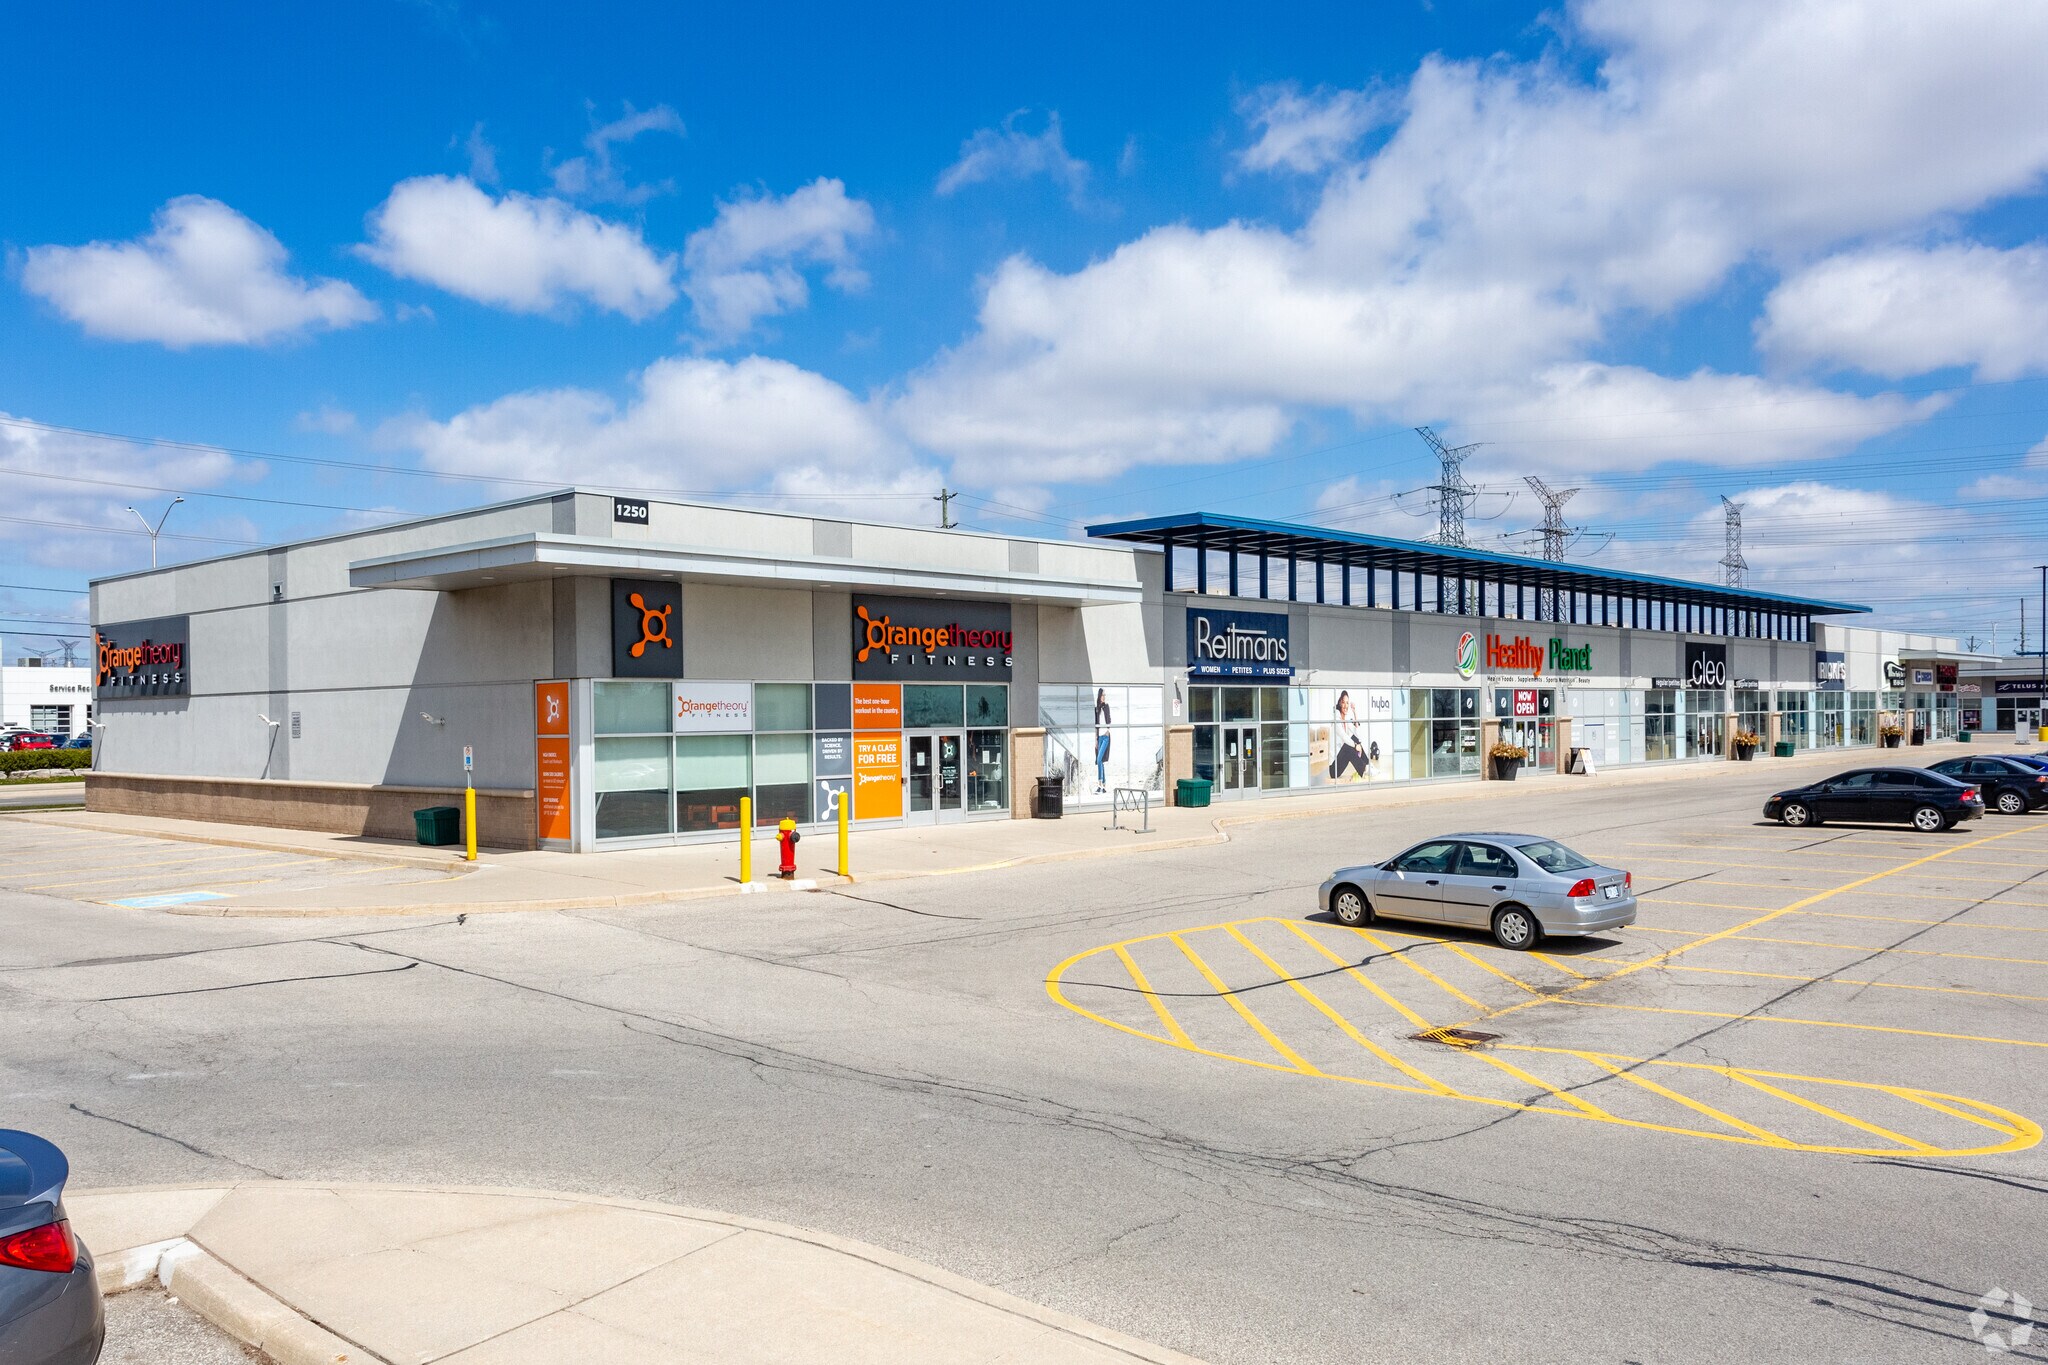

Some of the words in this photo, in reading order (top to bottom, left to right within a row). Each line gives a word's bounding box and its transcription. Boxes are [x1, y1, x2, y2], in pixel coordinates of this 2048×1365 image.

[616, 504, 647, 518] 1250
[1197, 616, 1288, 661] Reitmans
[891, 654, 1013, 667] FITNESS
[1486, 634, 1544, 680] Healthy
[1549, 638, 1592, 671] Planet
[1200, 665, 1220, 673] WOMEN
[1232, 666, 1252, 674] PETITES
[1262, 667, 1275, 675] PLUS
[1276, 667, 1290, 675] SIZES
[1692, 650, 1726, 686] cleo
[110, 672, 181, 687] FITNESS
[49, 684, 76, 693] Service
[77, 684, 92, 693] Rec
[1518, 691, 1532, 702] NOW
[1371, 695, 1390, 712] hyba
[1516, 702, 1535, 715] OPEN
[858, 744, 871, 753] TRY
[872, 744, 877, 752] A
[878, 743, 897, 752] CLASS
[858, 754, 875, 764] FOR
[877, 753, 897, 763] FREE
